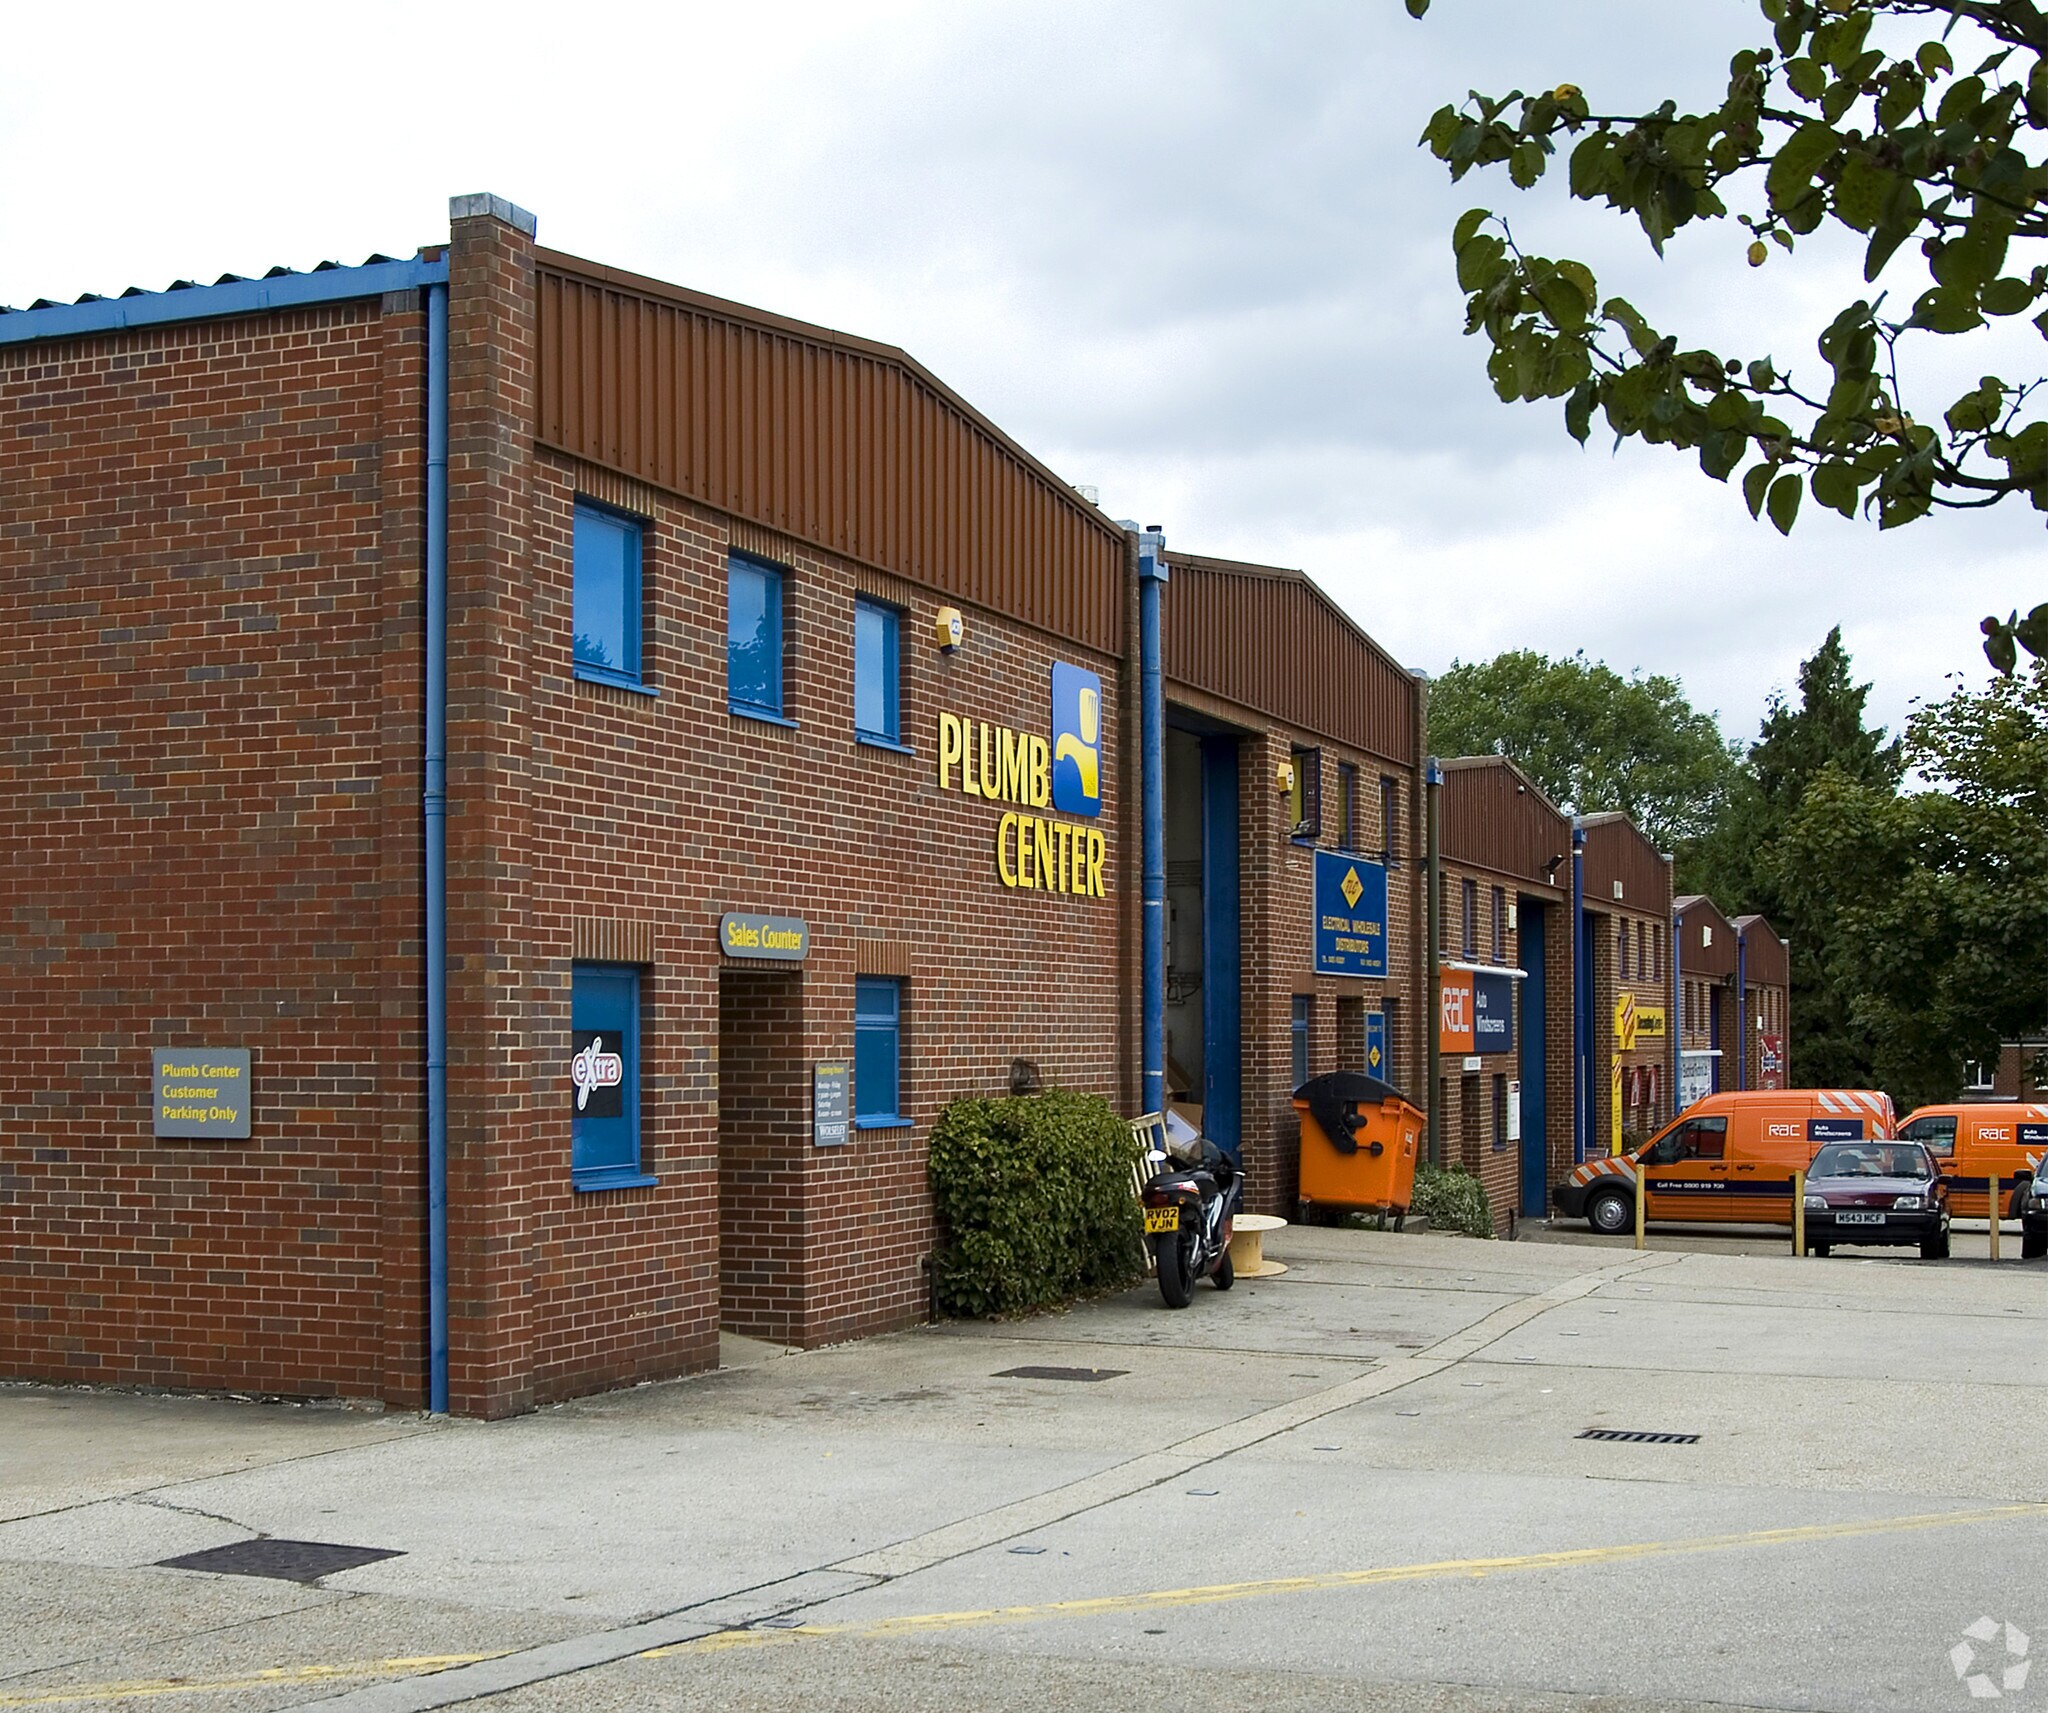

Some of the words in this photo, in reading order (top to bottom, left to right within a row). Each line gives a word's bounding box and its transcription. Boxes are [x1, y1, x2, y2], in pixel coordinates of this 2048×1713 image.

[939, 711, 1049, 809] PLUMB
[997, 811, 1106, 897] CENTER
[727, 921, 759, 948] Sales
[761, 924, 803, 950] Counter
[1476, 990, 1487, 1008] Auto
[1442, 987, 1470, 1033] RAC
[1476, 1014, 1505, 1033] Windscreens
[162, 1064, 199, 1078] Plumb
[201, 1064, 241, 1078] Center
[162, 1084, 218, 1099] Customer
[162, 1105, 207, 1123] Parking
[209, 1106, 237, 1123] Only
[1769, 1124, 1800, 1136] RAC
[1978, 1128, 2010, 1140] RAC
[1147, 1208, 1178, 1219] RV02
[1150, 1219, 1173, 1230] VJN
